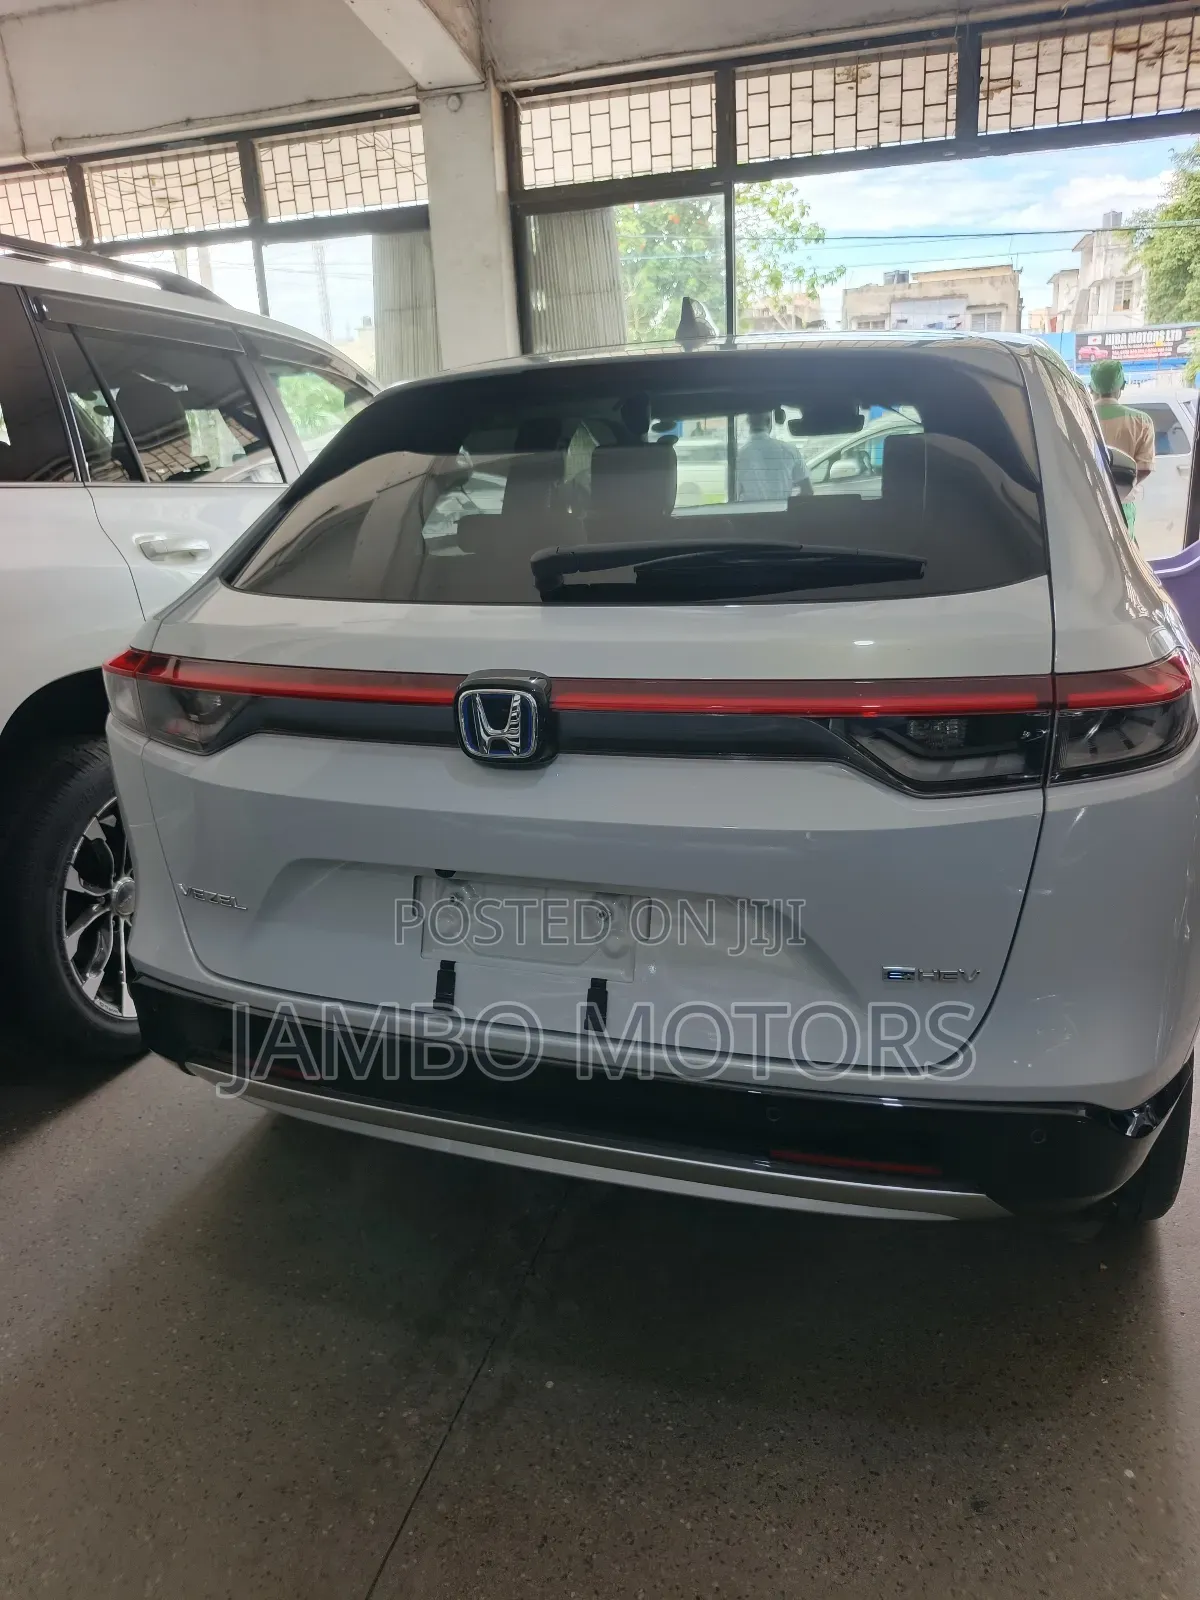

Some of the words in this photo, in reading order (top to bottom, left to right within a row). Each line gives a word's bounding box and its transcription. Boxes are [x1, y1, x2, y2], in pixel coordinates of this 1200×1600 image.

[1128, 330, 1165, 343] MOTORS
[1165, 328, 1183, 342] LTD
[176, 882, 247, 910] VEZEL
